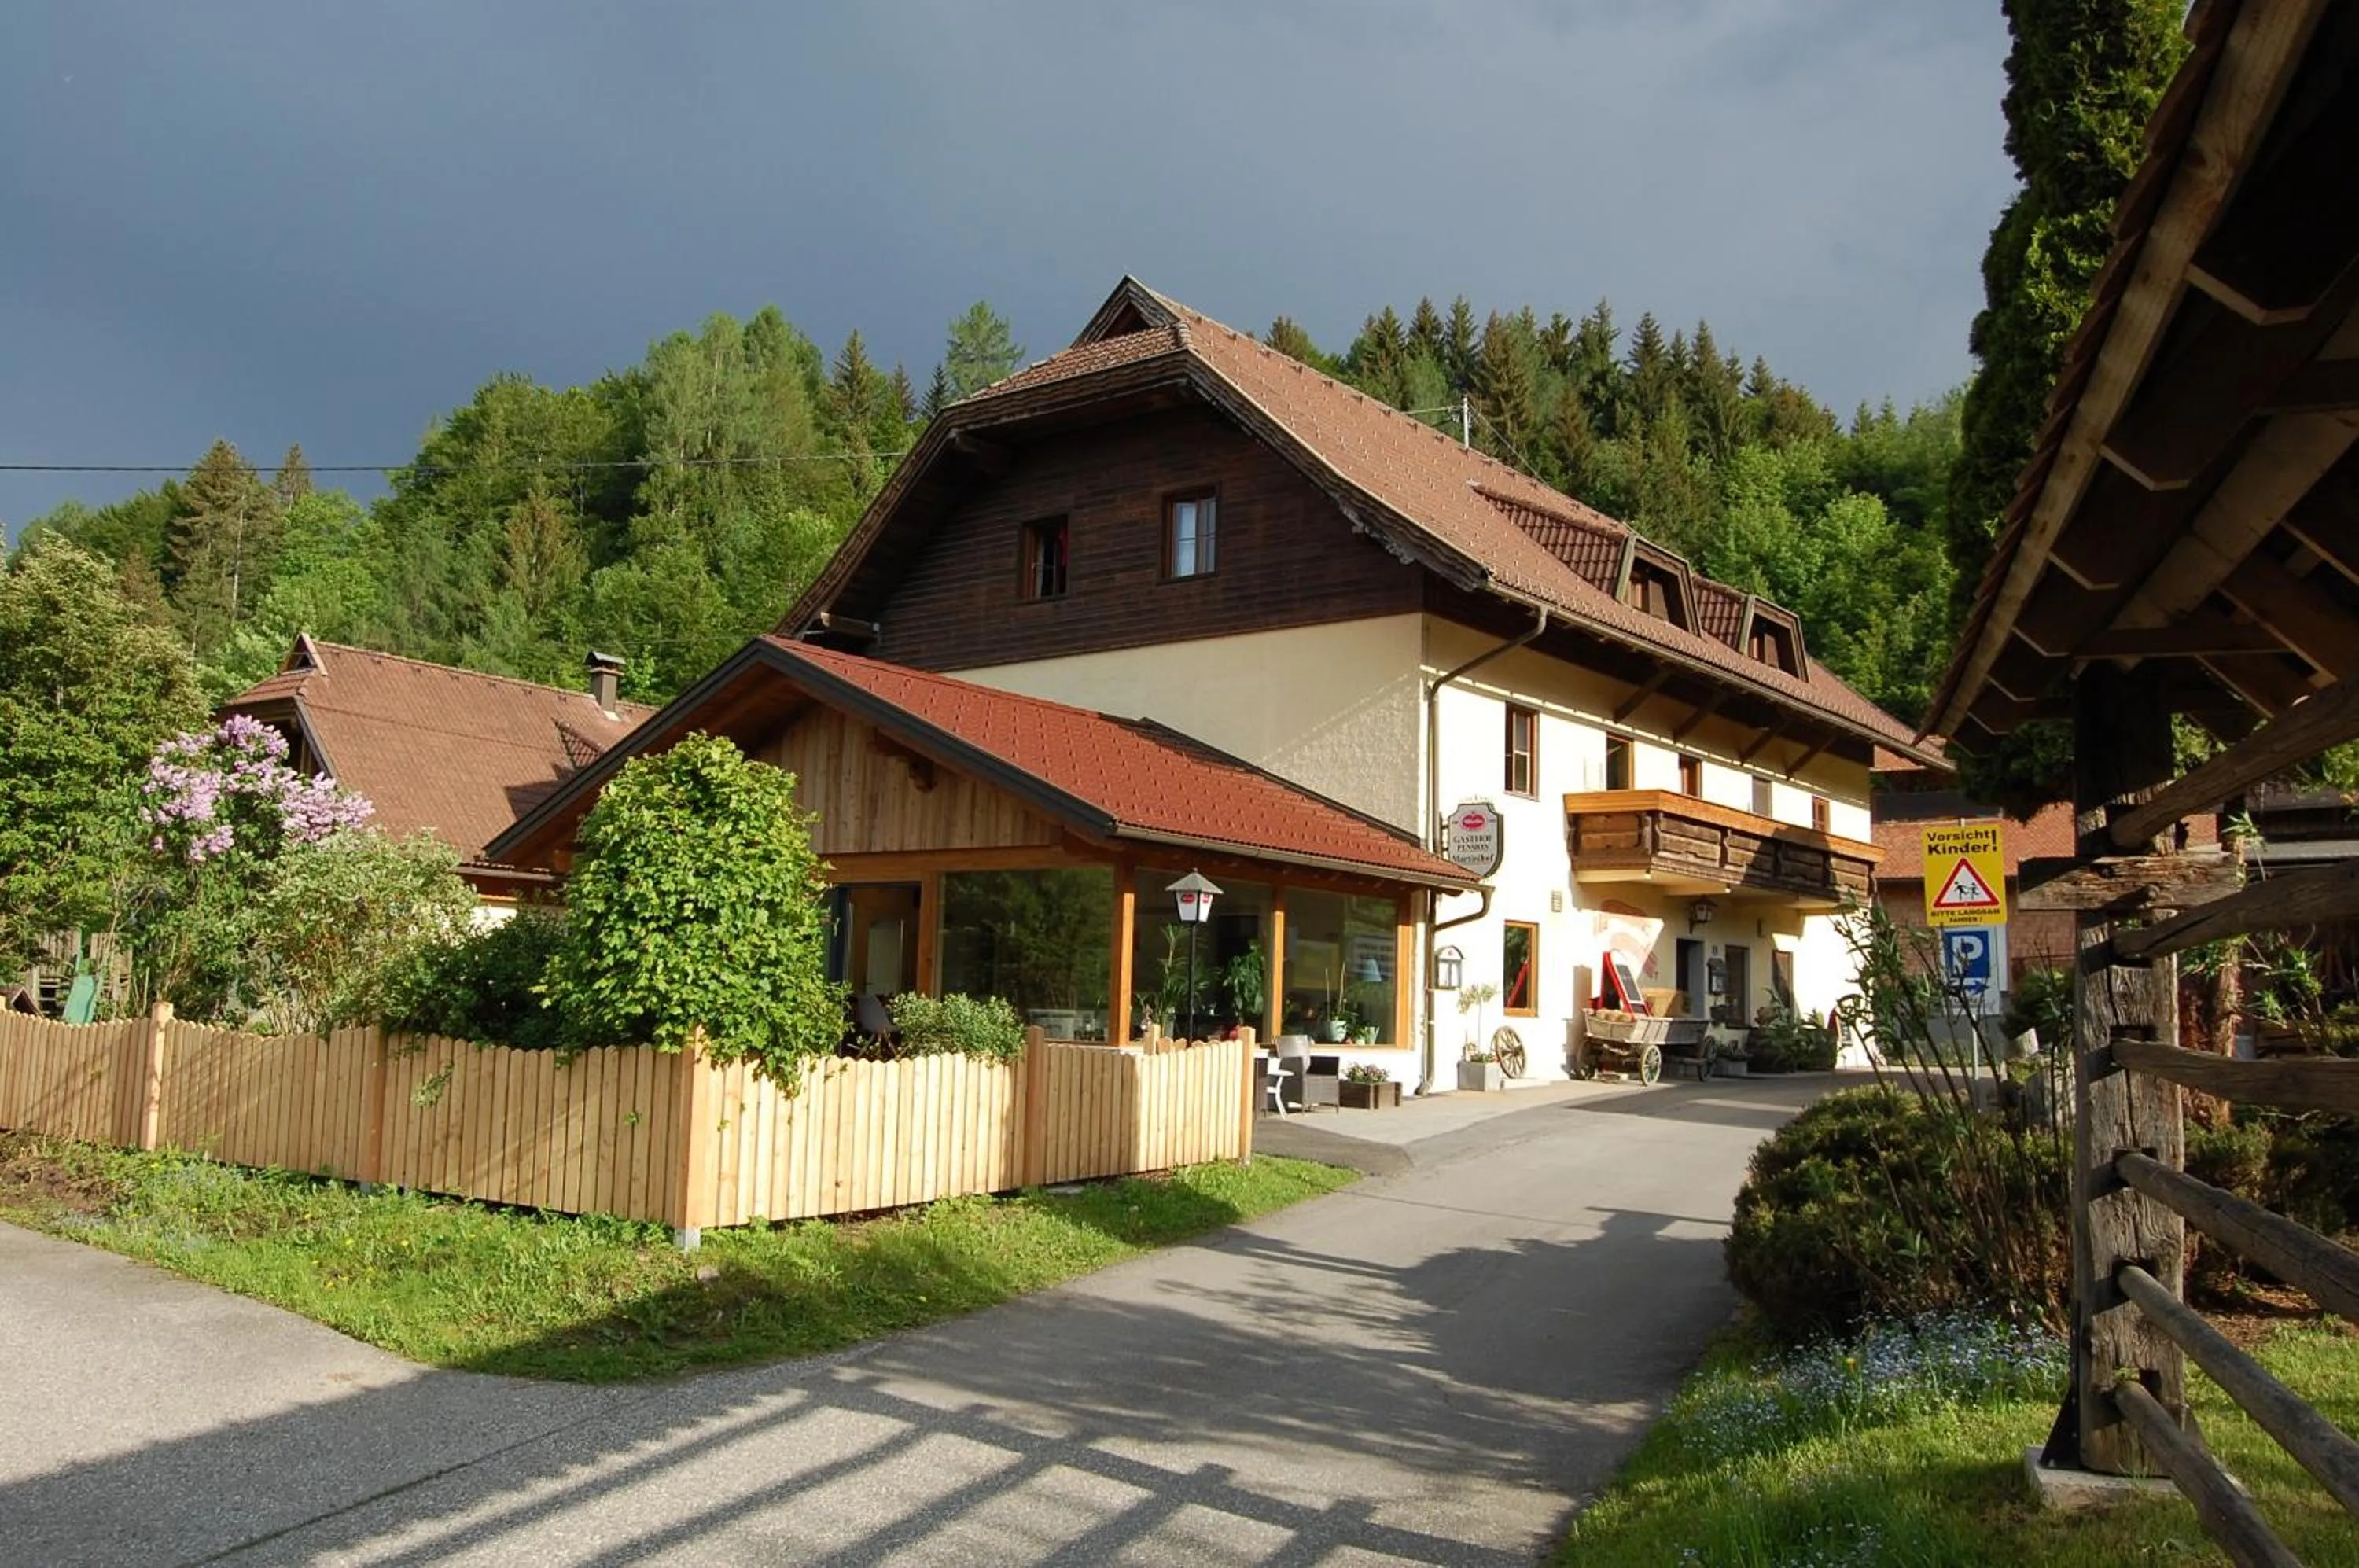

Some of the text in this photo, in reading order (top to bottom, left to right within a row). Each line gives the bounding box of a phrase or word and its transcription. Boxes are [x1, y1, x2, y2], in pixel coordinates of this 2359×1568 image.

[1452, 834, 1492, 844] GASTHOF
[1927, 830, 1990, 841] Vorsicht
[1457, 844, 1489, 852] PENSION
[1951, 935, 1984, 977] P
